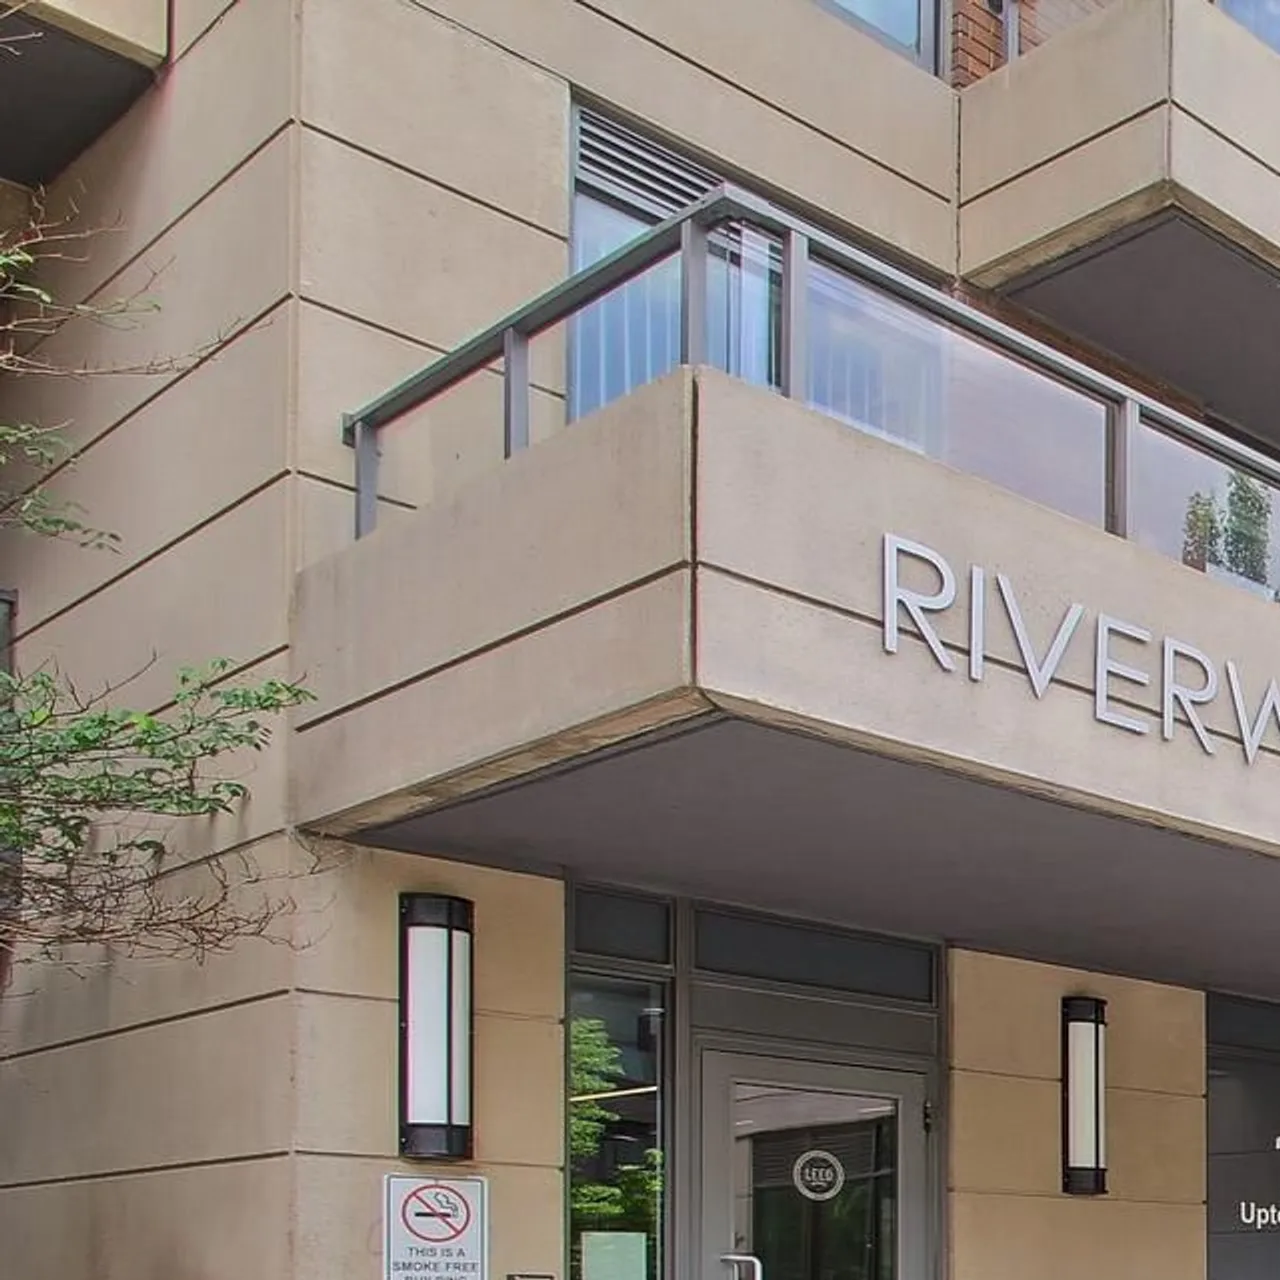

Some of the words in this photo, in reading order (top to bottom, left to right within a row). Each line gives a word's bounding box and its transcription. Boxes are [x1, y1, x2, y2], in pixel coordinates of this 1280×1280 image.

[407, 1247, 437, 1258] THIS
[441, 1247, 454, 1258] IS
[456, 1247, 466, 1258] A
[392, 1261, 440, 1272] SMOKE
[446, 1261, 480, 1272] FREE
